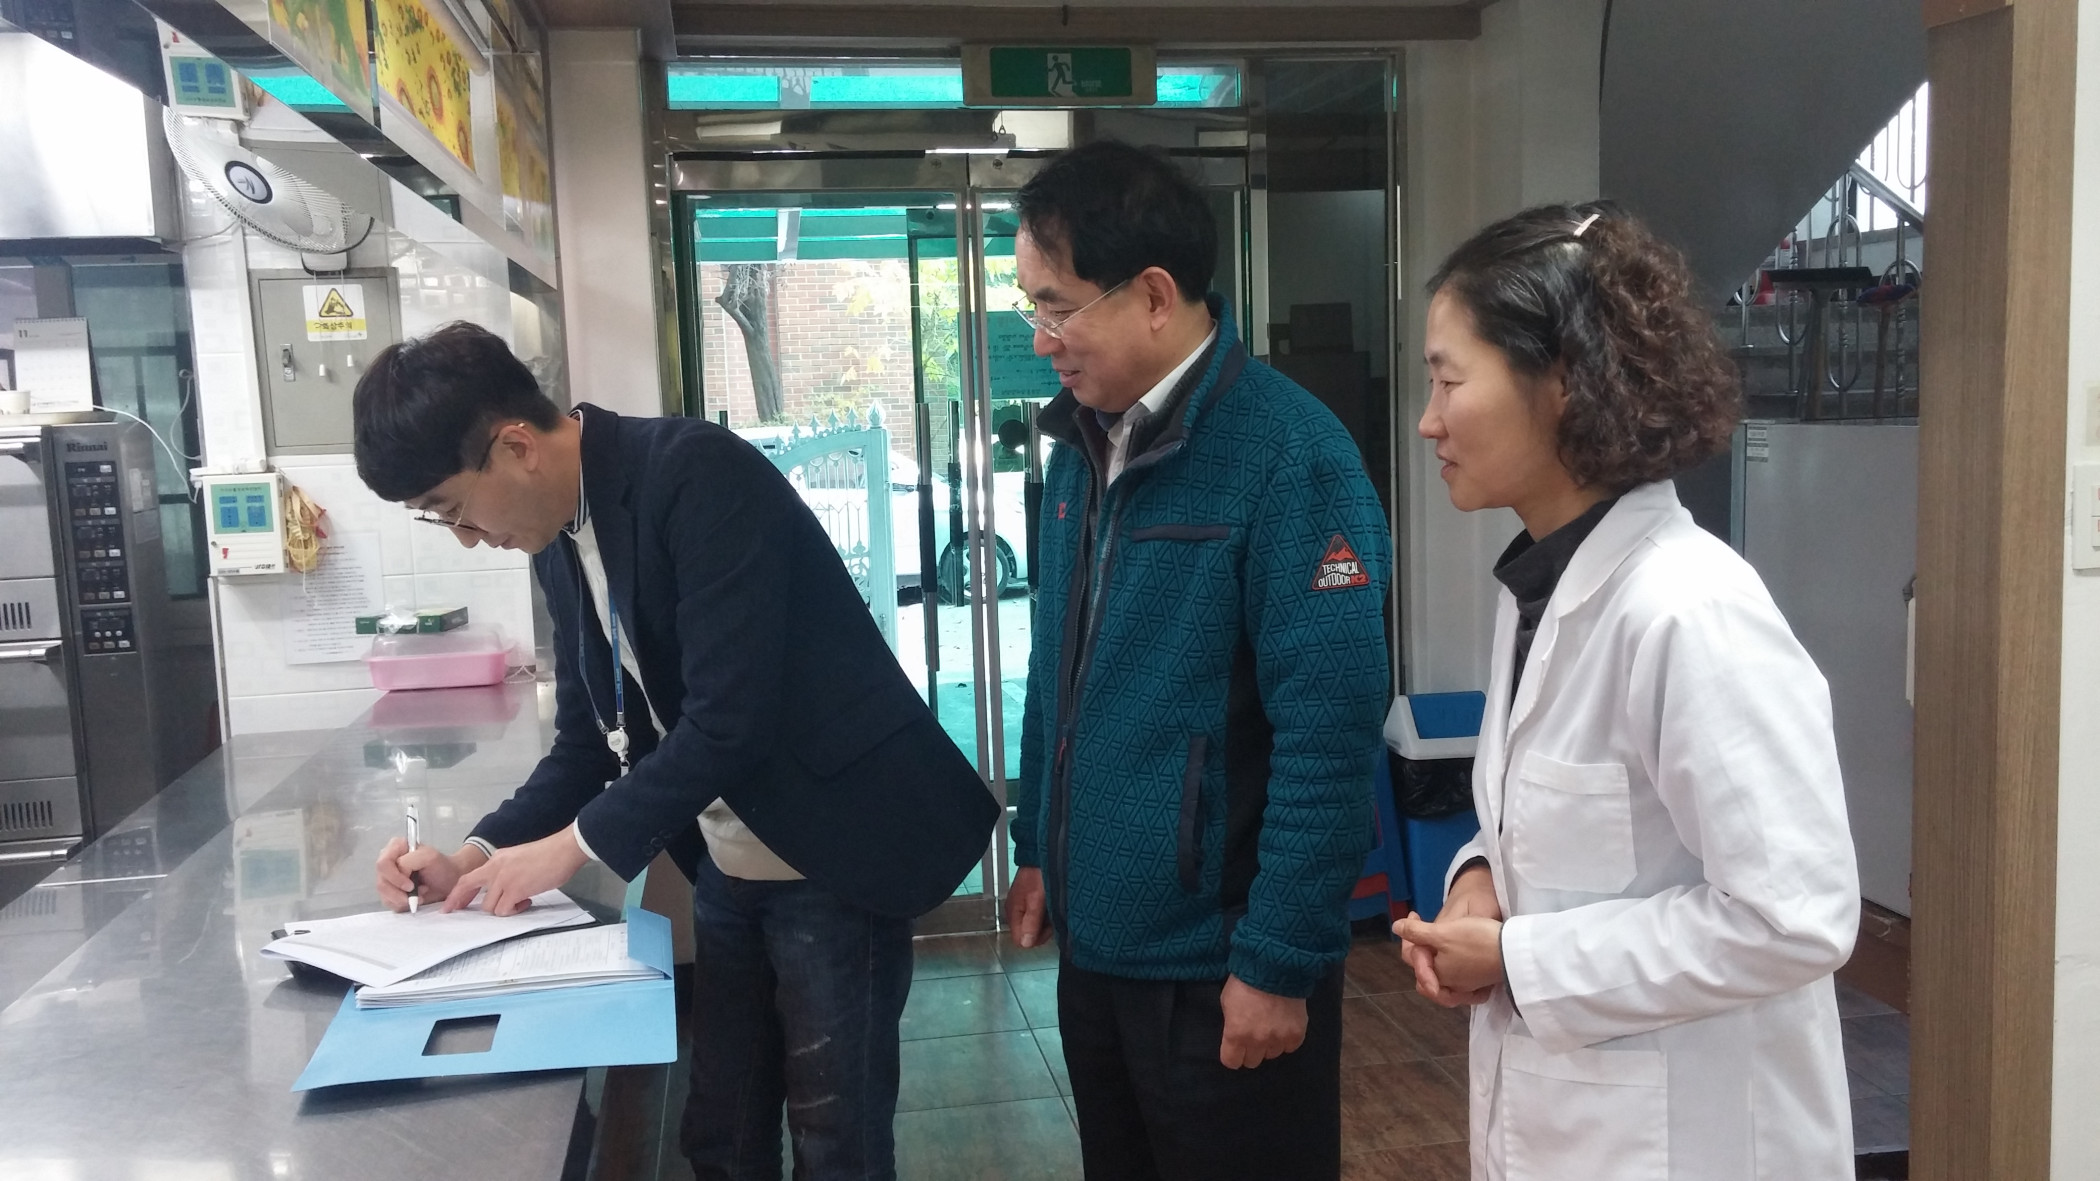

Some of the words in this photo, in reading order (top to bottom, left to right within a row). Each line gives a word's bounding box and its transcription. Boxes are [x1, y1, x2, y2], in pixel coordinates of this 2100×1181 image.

[67, 441, 108, 452] Rinnai
[1322, 561, 1360, 575] TECHNICAL
[1318, 573, 1351, 587] OUTDOOR
